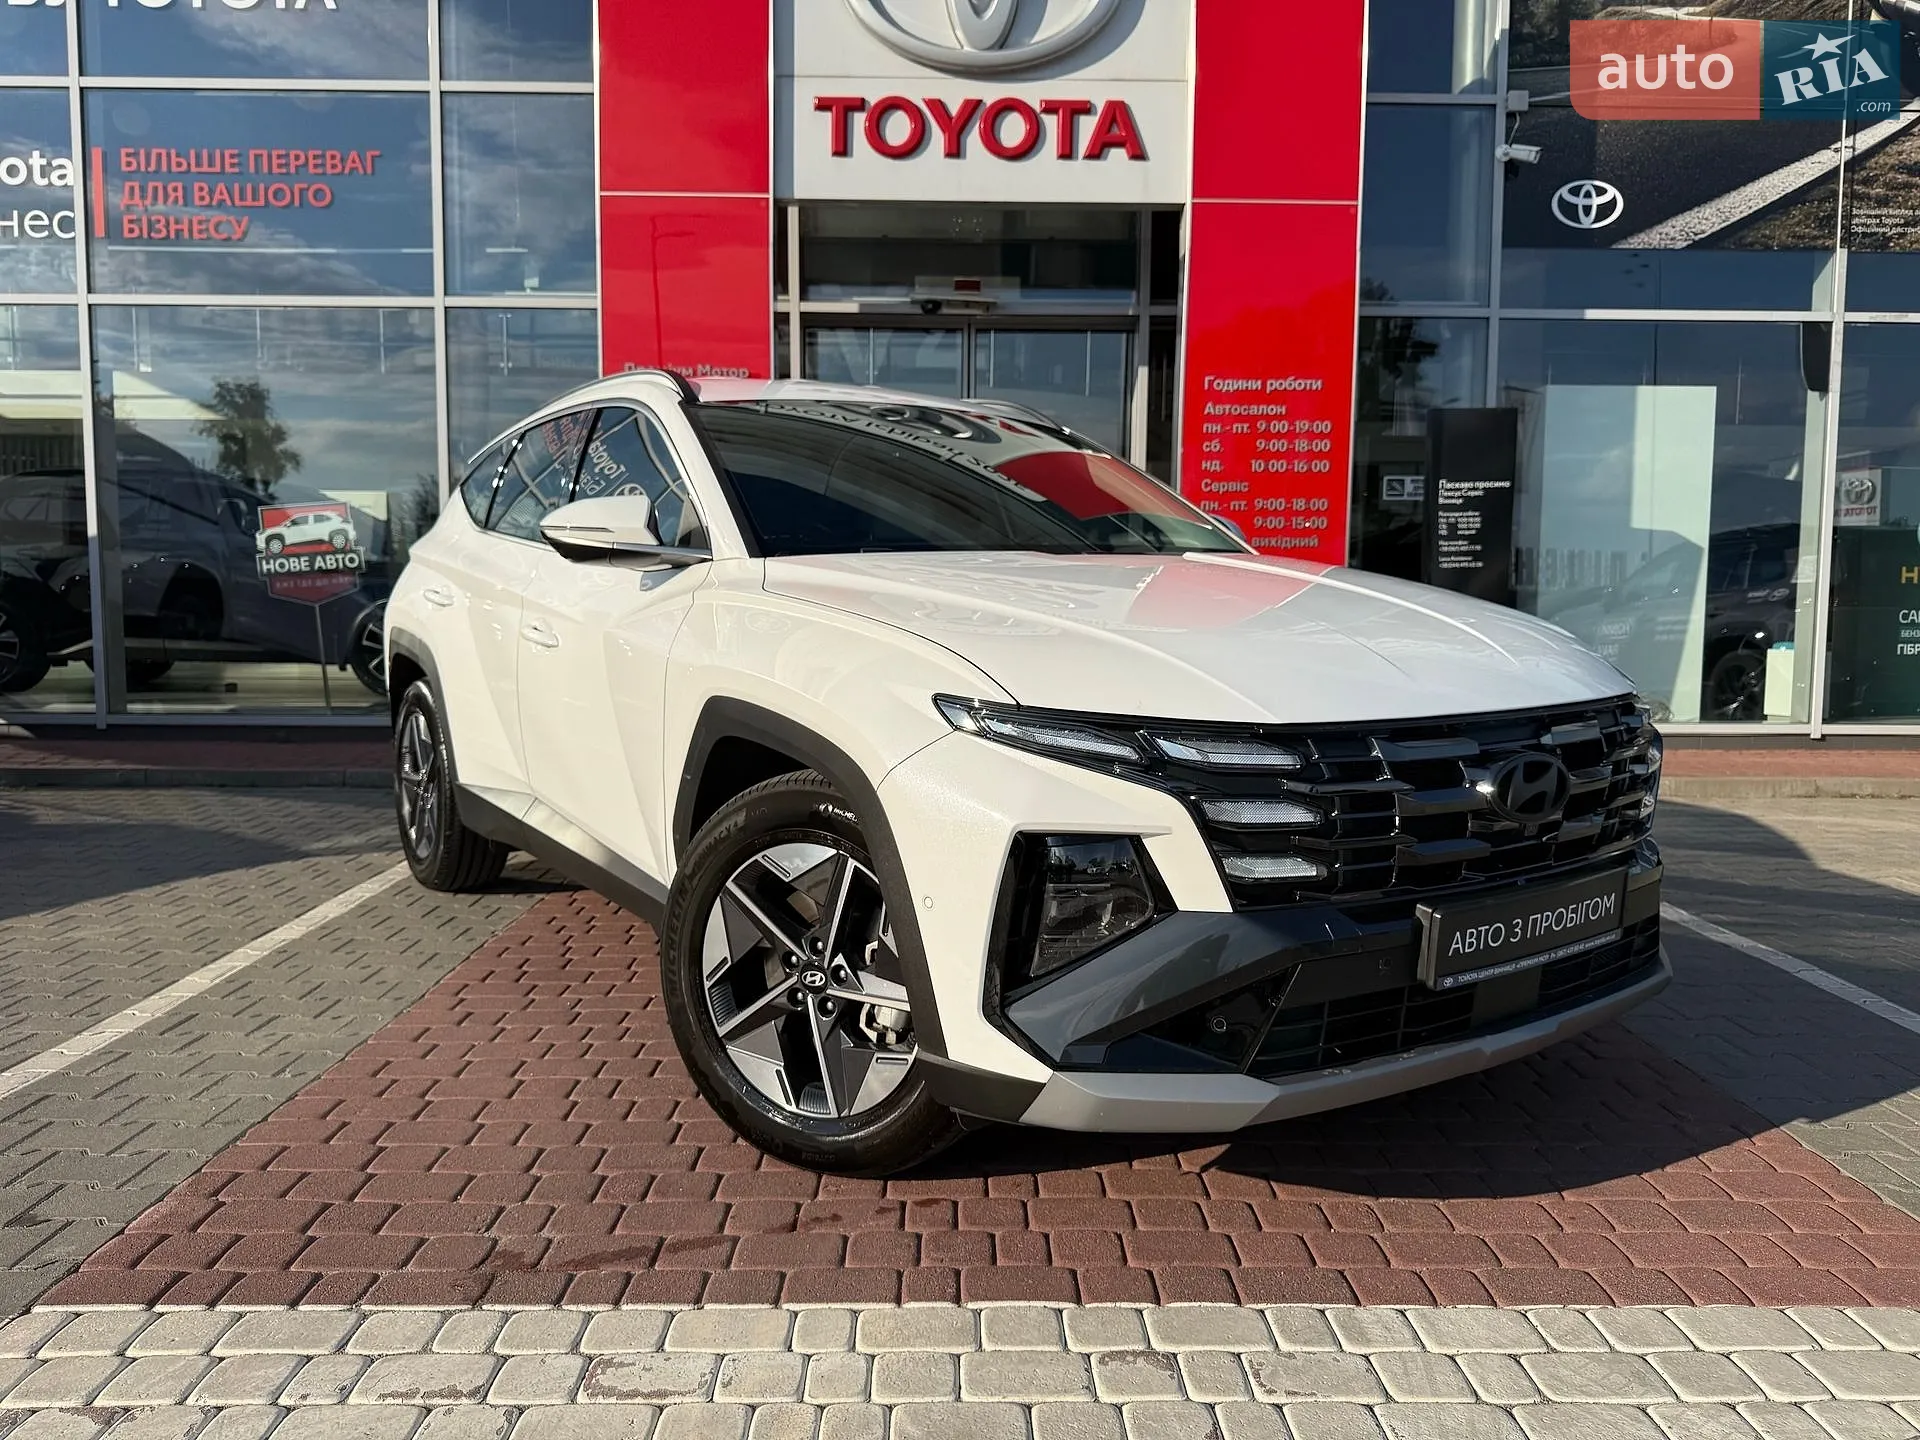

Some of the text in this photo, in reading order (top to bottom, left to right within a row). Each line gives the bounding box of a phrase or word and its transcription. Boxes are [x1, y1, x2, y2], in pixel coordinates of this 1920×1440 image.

[813, 95, 1147, 161] TOYOTA
[119, 148, 381, 176] БІЛЬШЕ ПЕРЕВАГ
[120, 180, 333, 210] ДЛЯ ВАШОГО
[122, 215, 250, 241] БІЗНЕСУ
[1881, 216, 1905, 226] Toyota
[1203, 376, 1323, 394] Години роботи
[1203, 400, 1287, 416] Автосалон
[1202, 438, 1331, 453] сб. 9:00-18:00
[1201, 459, 1224, 473] нд.
[1201, 478, 1250, 495] Сервіс
[1254, 498, 1329, 512] 9:00-18:00
[1251, 534, 1319, 549] вихідний
[261, 552, 360, 574] НОВЕ АВТО
[1448, 922, 1505, 957] АВТО
[1526, 892, 1616, 939] ПРОБІГОМ
